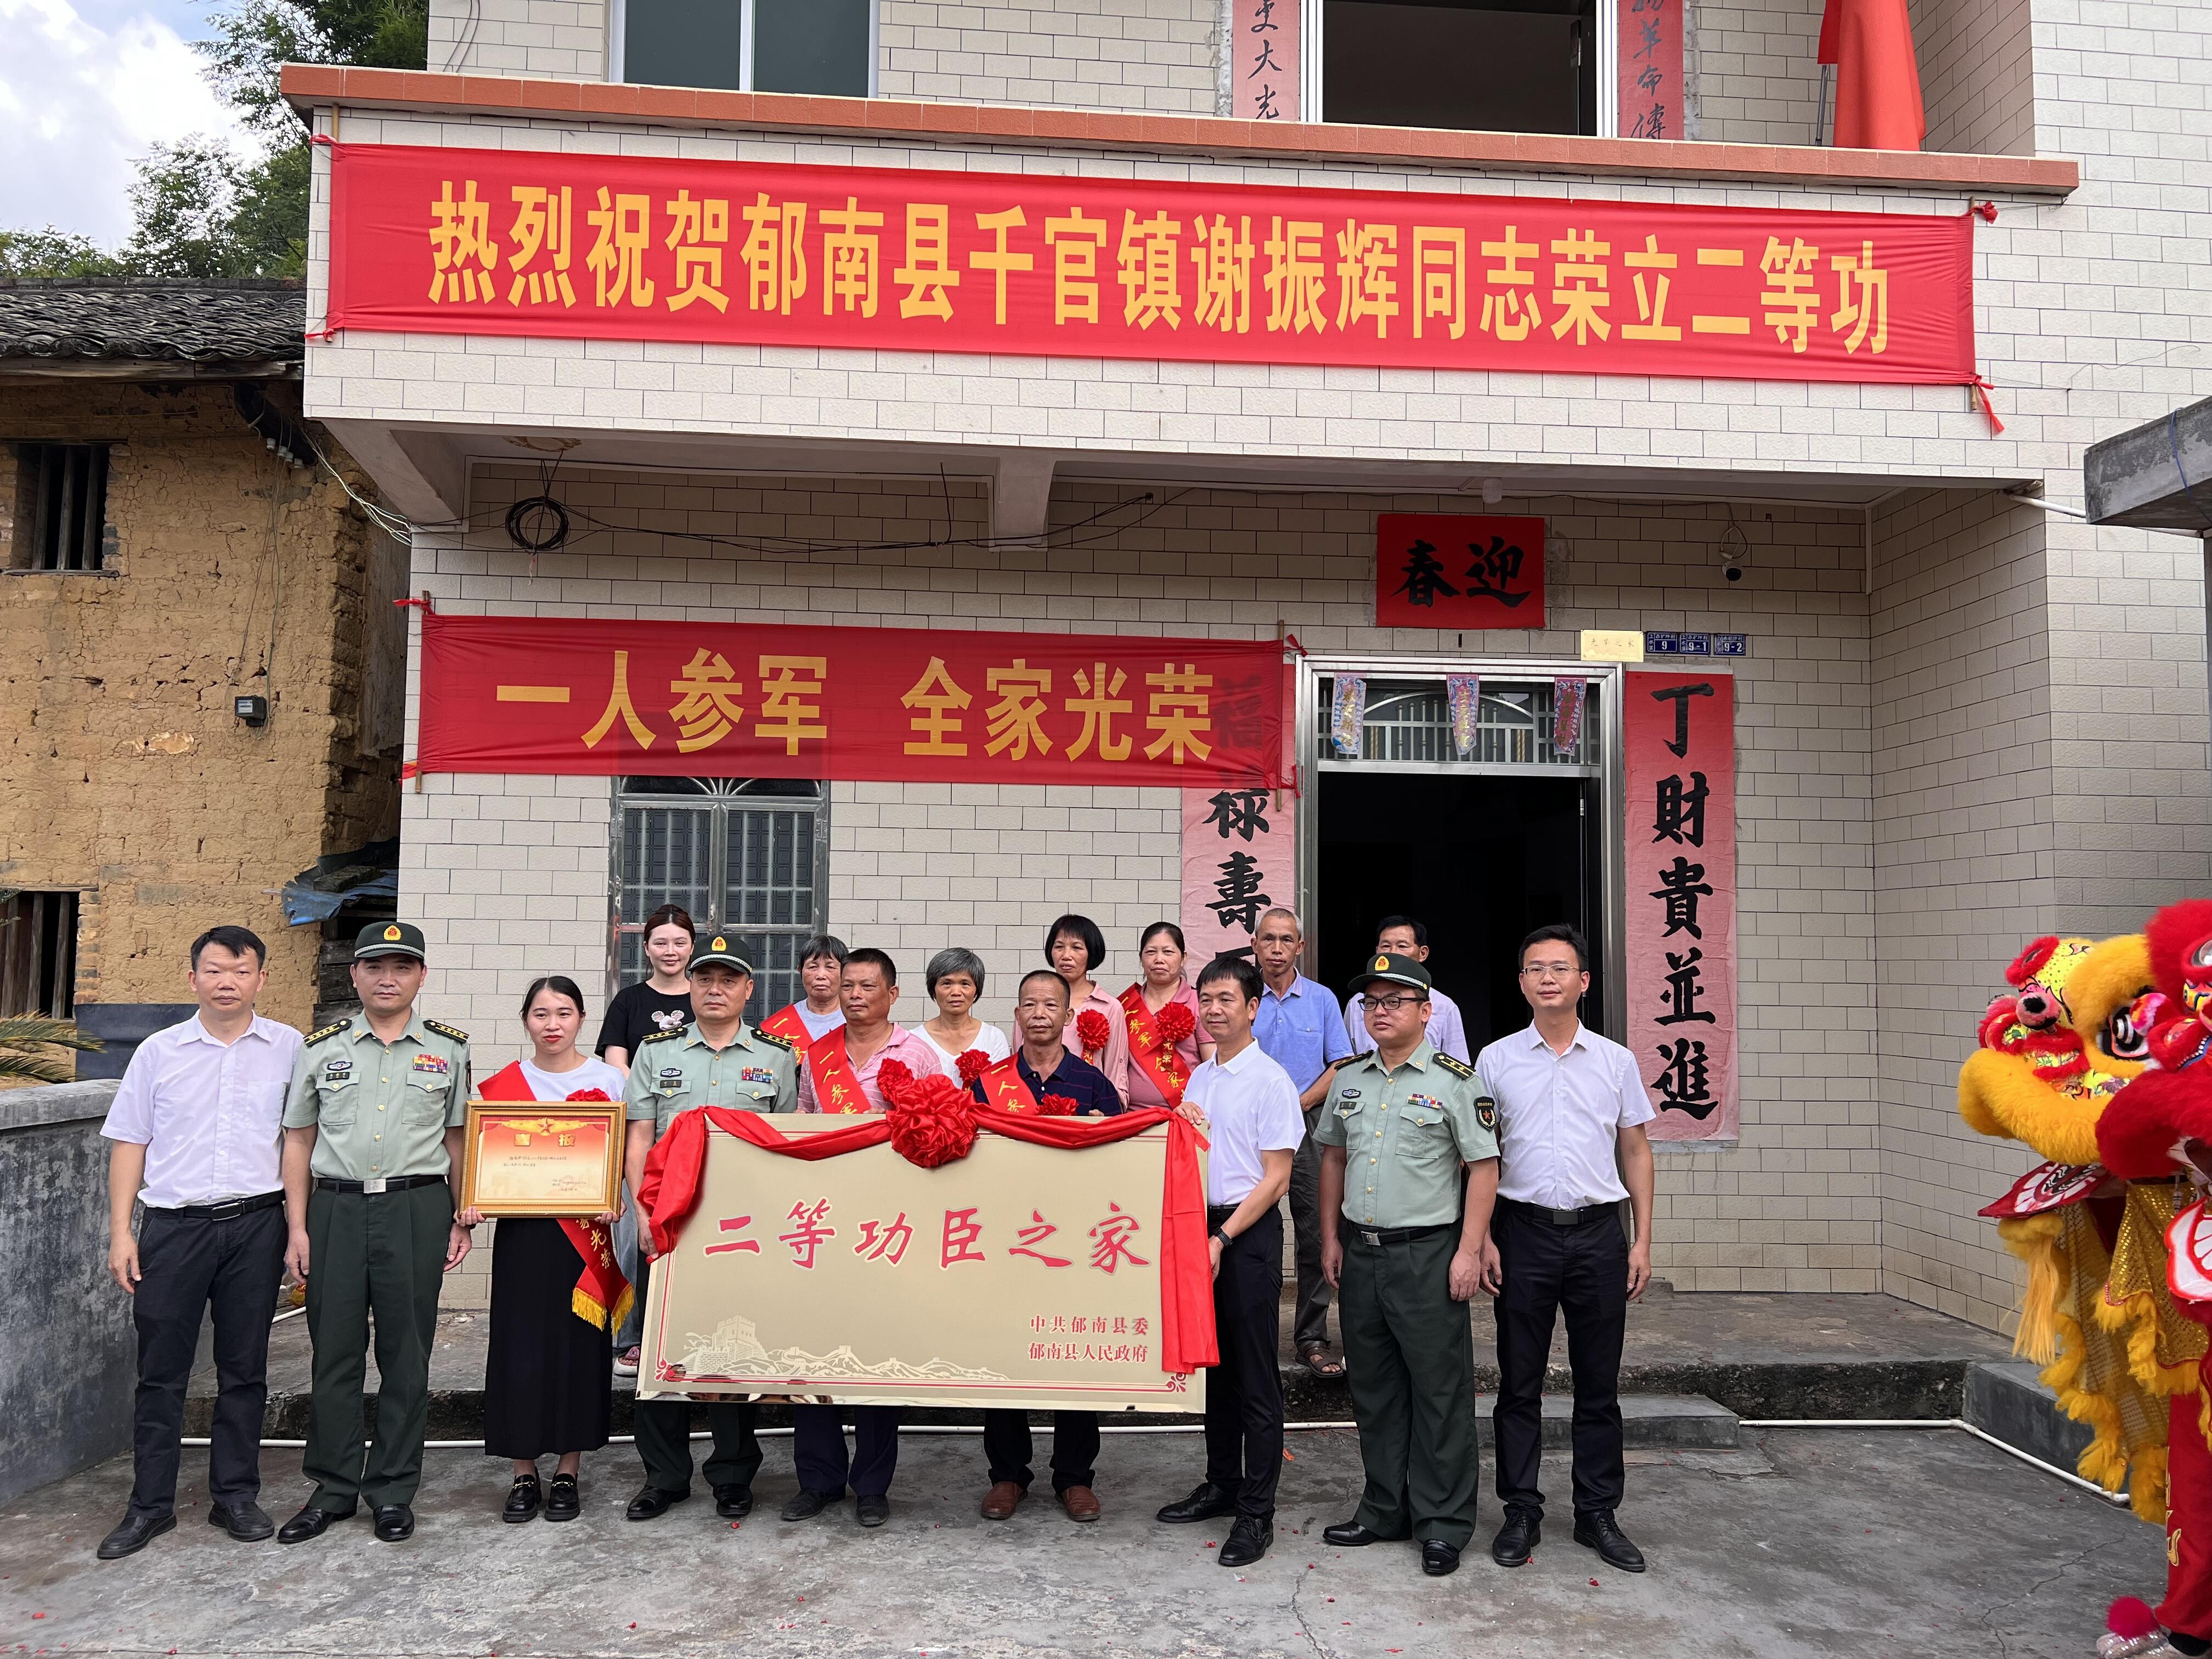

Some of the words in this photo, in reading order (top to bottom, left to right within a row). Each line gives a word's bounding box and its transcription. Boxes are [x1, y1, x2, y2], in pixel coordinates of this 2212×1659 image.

[428, 180, 1887, 354] 热烈祝贺郁南县千官镇谢振辉同志荣立二等功
[1662, 641, 1667, 650] 9
[1689, 642, 1707, 651] 9-1
[1724, 642, 1742, 652] 9-2
[496, 647, 827, 755] 一人参军
[900, 656, 1213, 764] 全家光荣
[704, 1198, 1150, 1274] 二等功臣之家
[1030, 1315, 1149, 1335] 中共郁南县委
[1028, 1342, 1149, 1363] 郁南县人民政府
